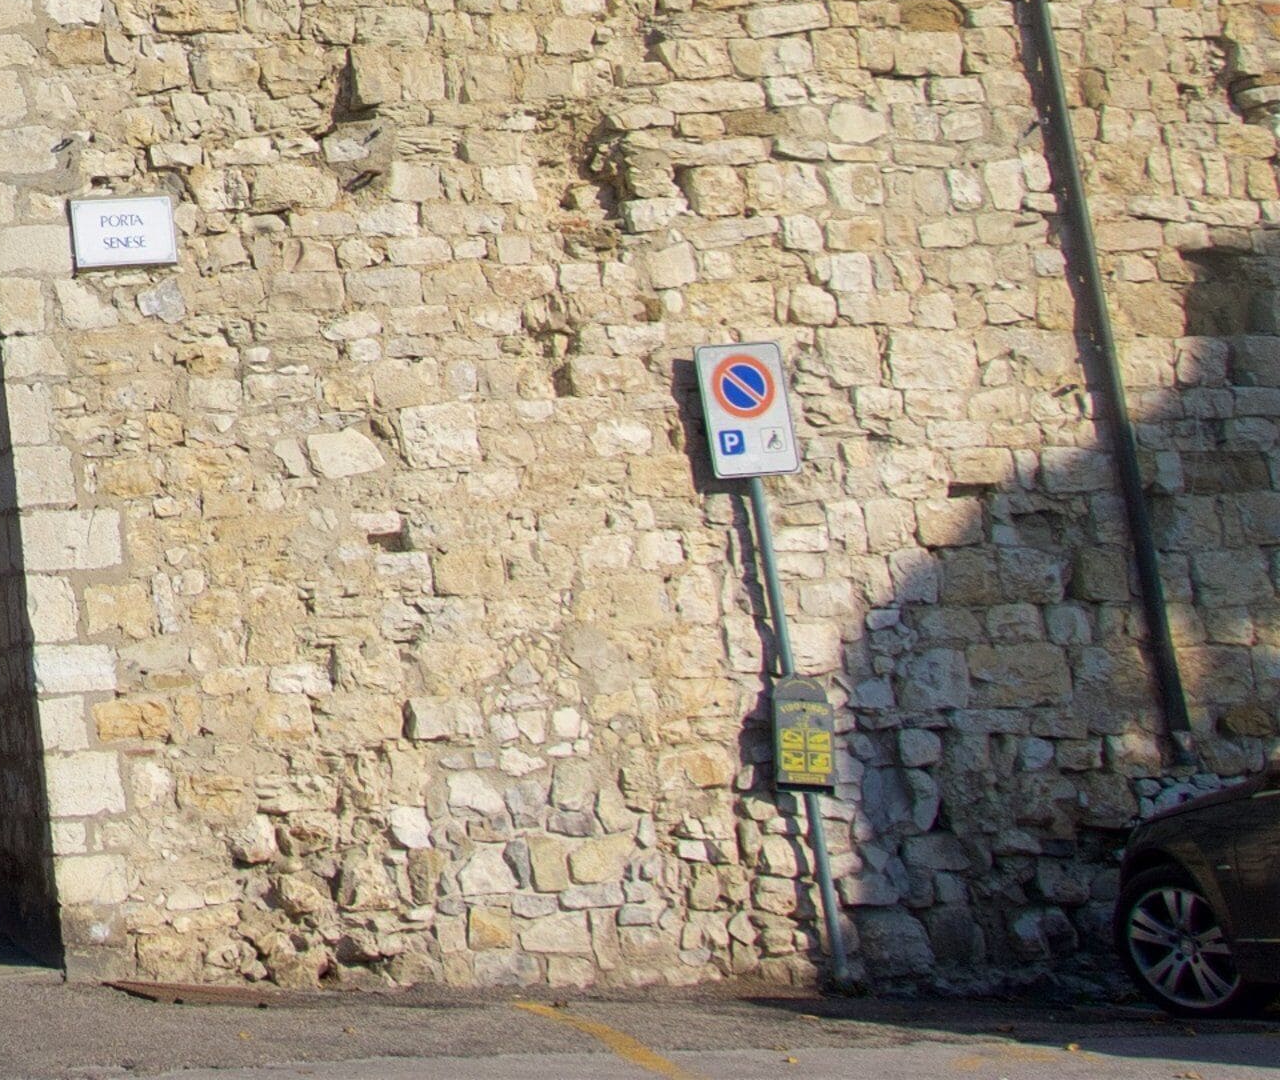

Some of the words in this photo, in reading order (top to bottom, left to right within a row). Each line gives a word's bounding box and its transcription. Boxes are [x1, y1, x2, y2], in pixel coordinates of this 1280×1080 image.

[100, 215, 143, 227] PORTA
[103, 236, 146, 249] SENESE
[725, 433, 739, 452] P
